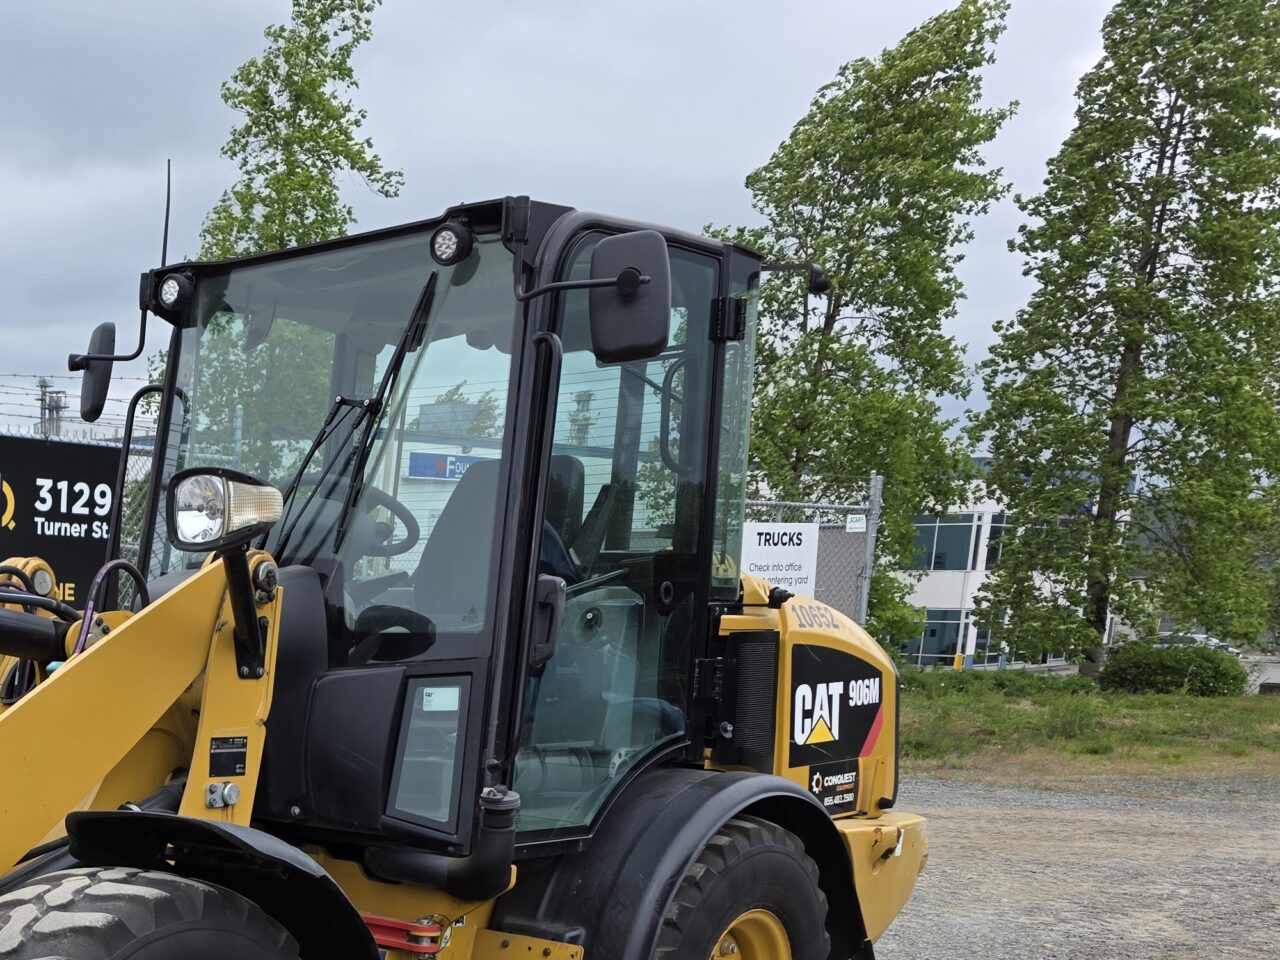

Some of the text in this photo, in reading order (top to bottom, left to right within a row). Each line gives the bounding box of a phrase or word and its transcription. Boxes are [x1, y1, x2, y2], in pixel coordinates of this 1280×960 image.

[34, 478, 112, 516] 3129
[34, 517, 88, 537] Turner
[757, 531, 803, 547] TRUCKS
[749, 562, 770, 572] Check
[785, 562, 802, 572] office
[794, 575, 809, 587] yard
[791, 604, 840, 629] 10652
[793, 677, 880, 746] CAT 906M
[823, 771, 856, 787] CONQUEST
